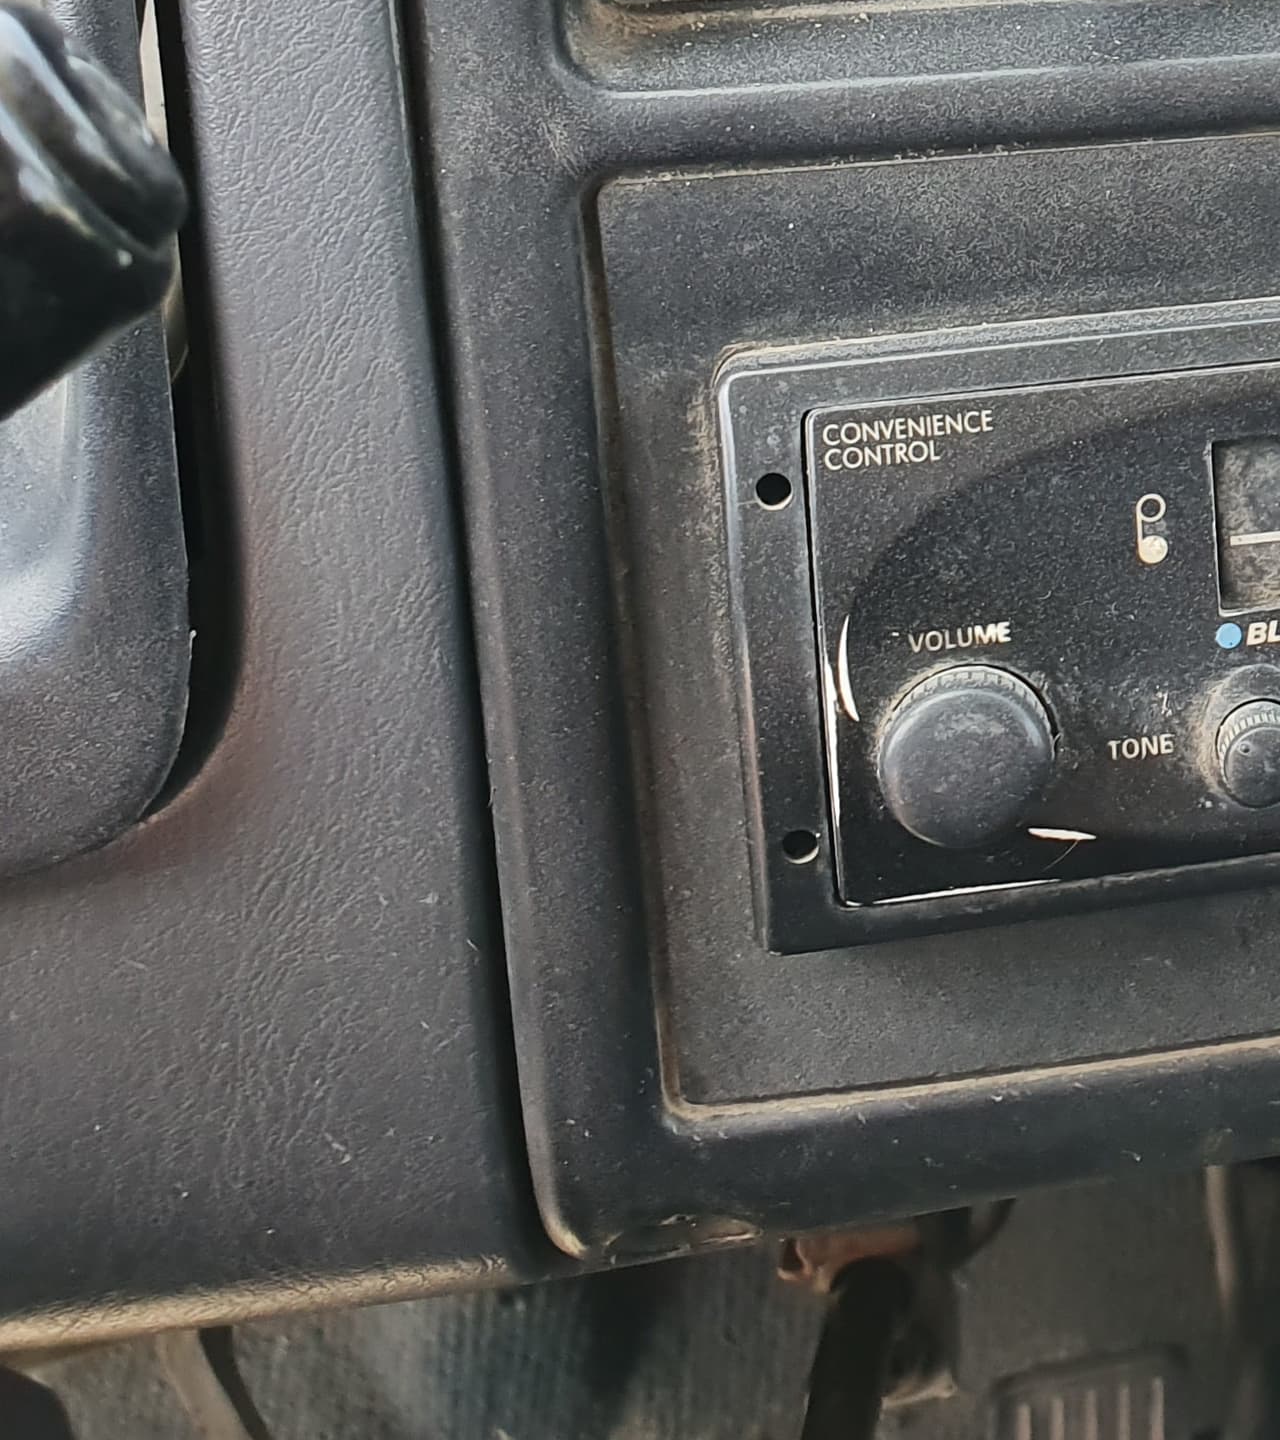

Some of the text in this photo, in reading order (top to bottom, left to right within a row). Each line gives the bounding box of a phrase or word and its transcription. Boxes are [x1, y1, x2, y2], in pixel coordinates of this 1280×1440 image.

[822, 410, 994, 447] CONVENIENCE
[824, 442, 940, 472] CONTROL
[907, 622, 1011, 653] VOLUME
[1107, 733, 1175, 761] TONE
